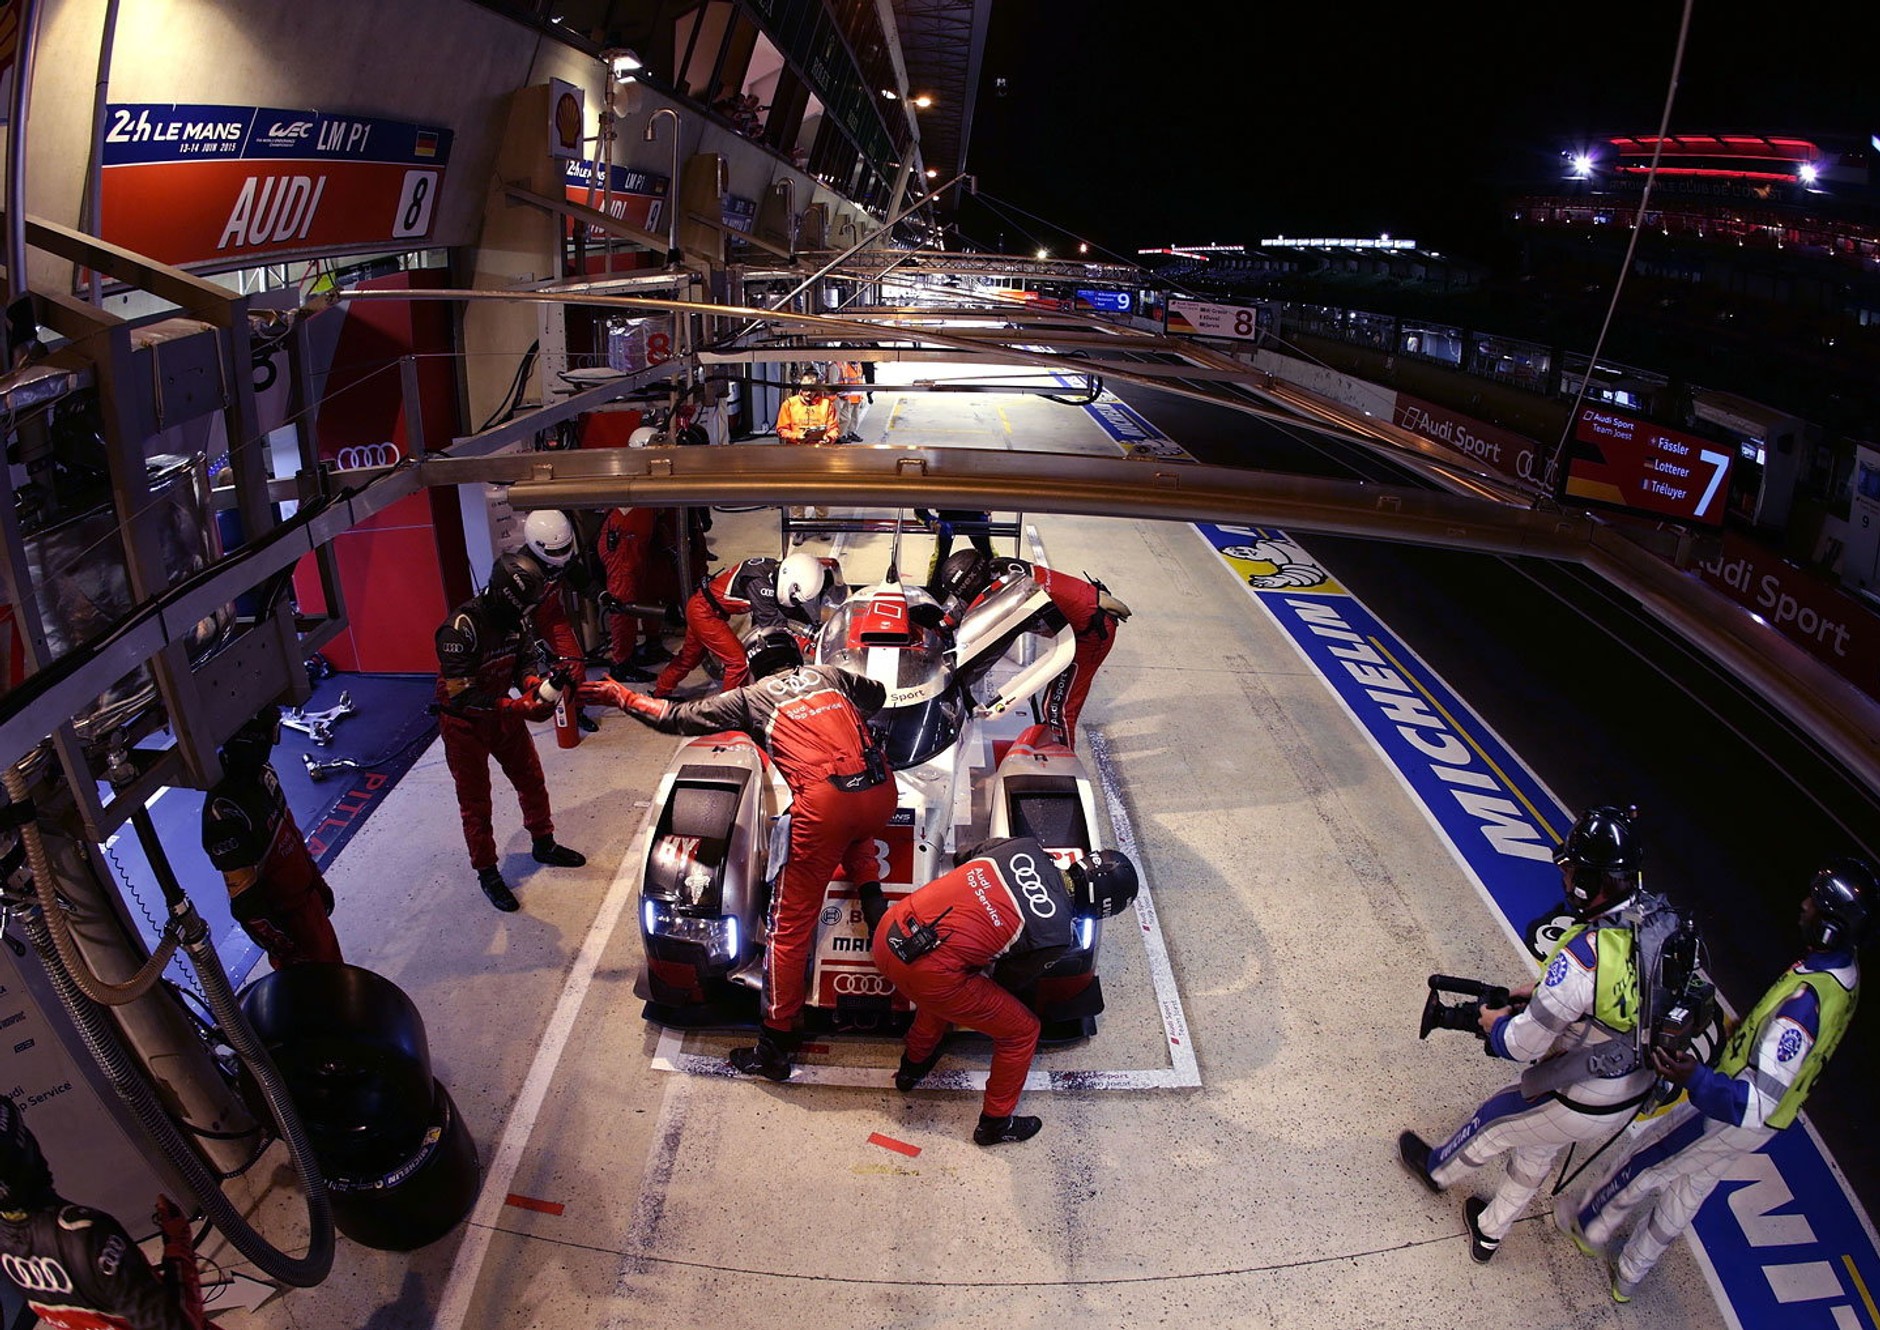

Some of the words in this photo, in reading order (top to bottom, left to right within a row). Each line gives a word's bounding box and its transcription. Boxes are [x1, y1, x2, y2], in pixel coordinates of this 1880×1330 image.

[153, 122, 182, 141] LE
[182, 122, 242, 140] MANS
[316, 120, 346, 151] LM
[346, 122, 372, 153] P1
[179, 143, 199, 153] 13-14
[219, 142, 237, 152] 2015
[217, 175, 327, 249] AUDI
[403, 177, 429, 231] 8
[1118, 293, 1130, 309] 9
[1234, 310, 1253, 336] 8
[647, 333, 670, 364] 8
[1593, 423, 1613, 435] Team
[1594, 413, 1612, 424] Audi
[1613, 417, 1634, 431] Sport
[1419, 412, 1453, 440] Audi
[1455, 425, 1503, 463] Sport
[1657, 437, 1690, 456] Fässler
[1654, 459, 1690, 478] Lotterer
[1651, 480, 1687, 500] Tréluyer
[1693, 449, 1730, 517] 7
[1862, 515, 1870, 528] 9
[1756, 574, 1851, 657] Sport
[890, 689, 926, 703] Sport
[1052, 672, 1068, 702] Sport
[1050, 703, 1060, 725] Audi
[1284, 598, 1554, 864] MICHELIN
[974, 867, 992, 889] Audi
[965, 869, 978, 888] Top
[974, 887, 1002, 928] Service
[9, 1085, 25, 1101] udi
[27, 1082, 72, 1107] Service
